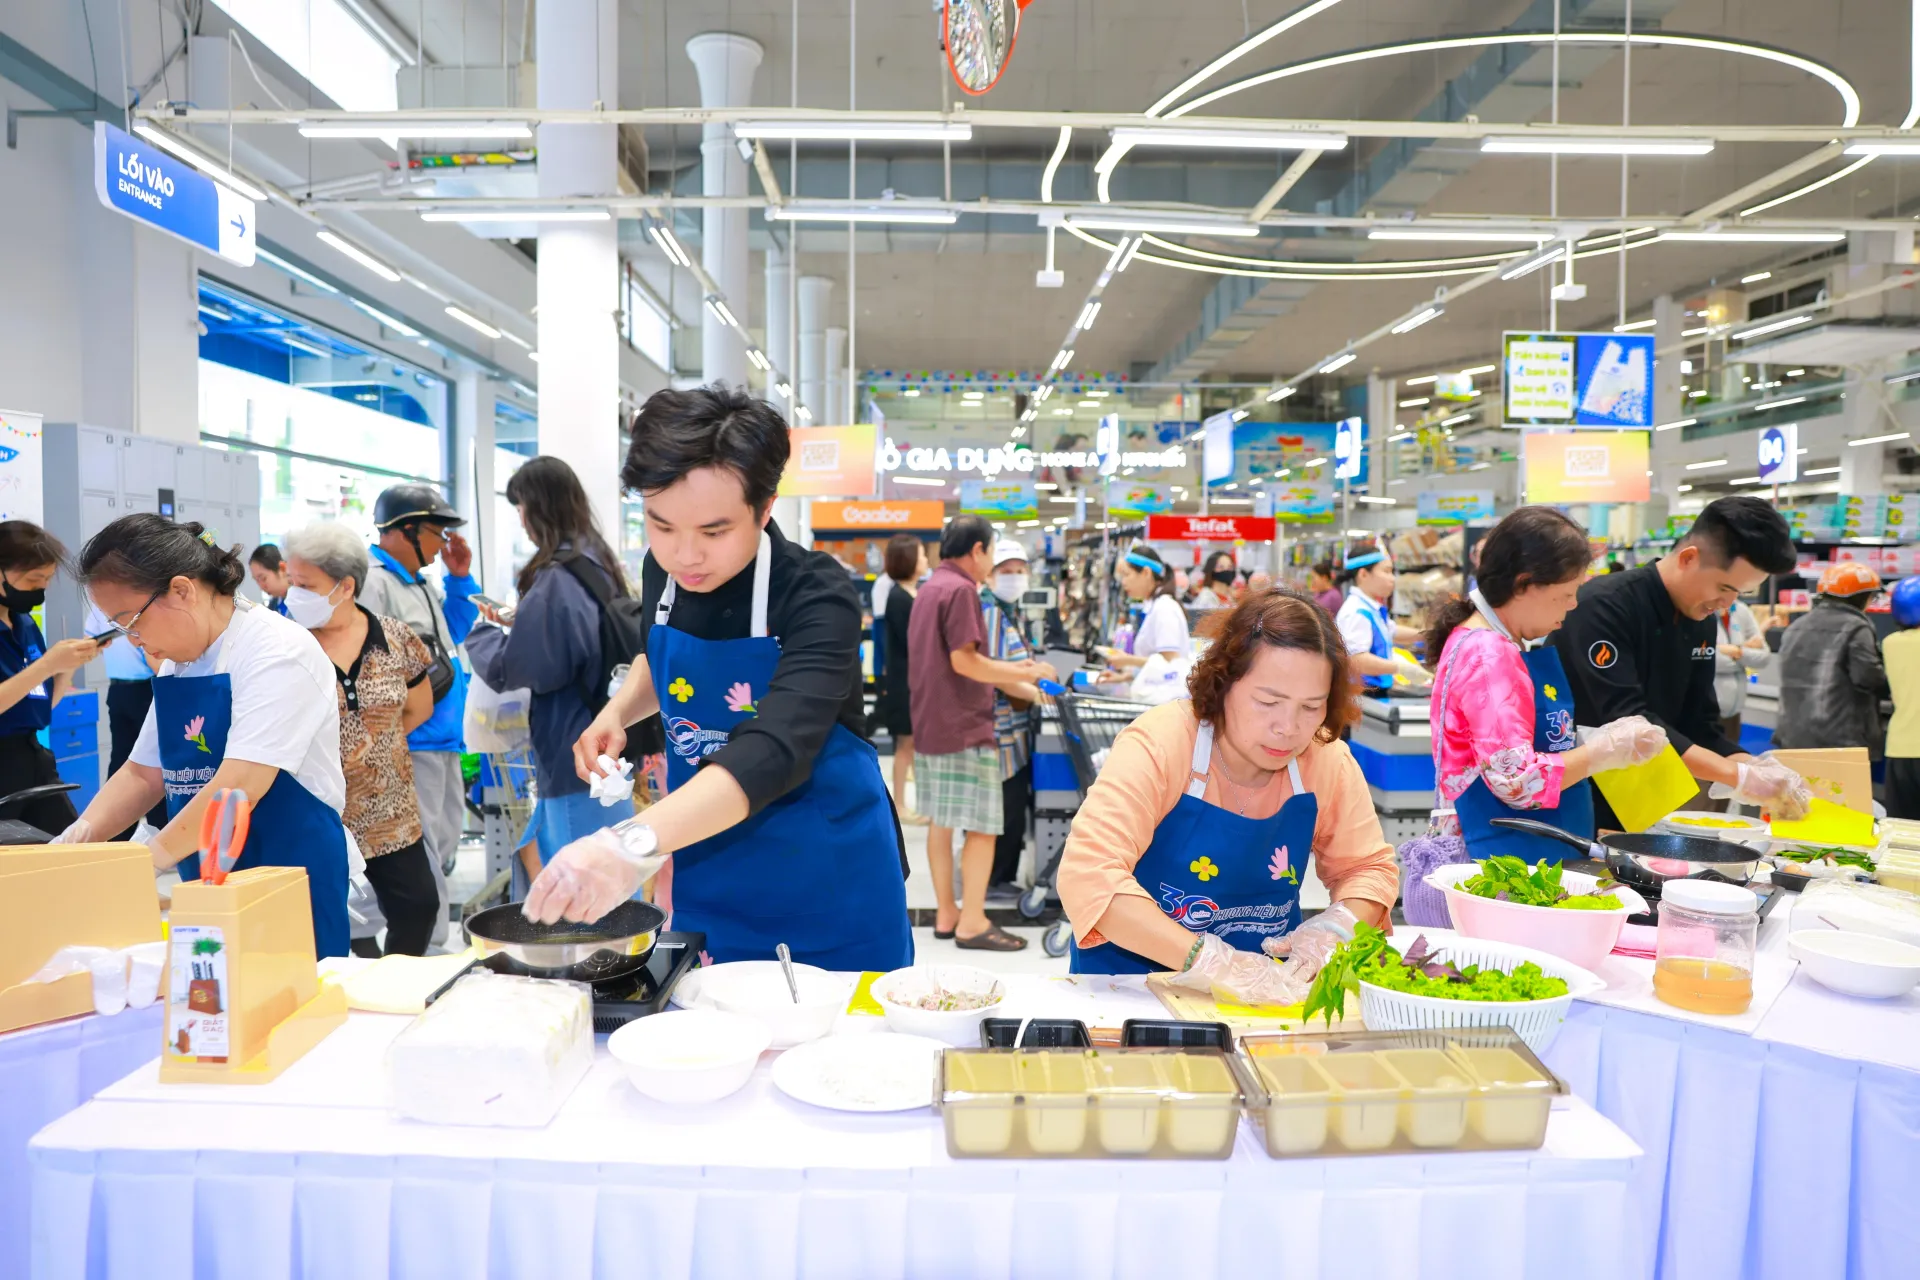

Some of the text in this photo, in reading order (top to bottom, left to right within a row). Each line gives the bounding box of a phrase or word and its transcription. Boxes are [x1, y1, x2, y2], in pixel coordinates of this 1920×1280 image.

[119, 152, 174, 197] LỐI VÀO
[118, 177, 162, 210] ENTRANCE
[906, 447, 952, 472] GIA
[957, 447, 1034, 477] DỤNG
[1187, 518, 1237, 533] Tefal
